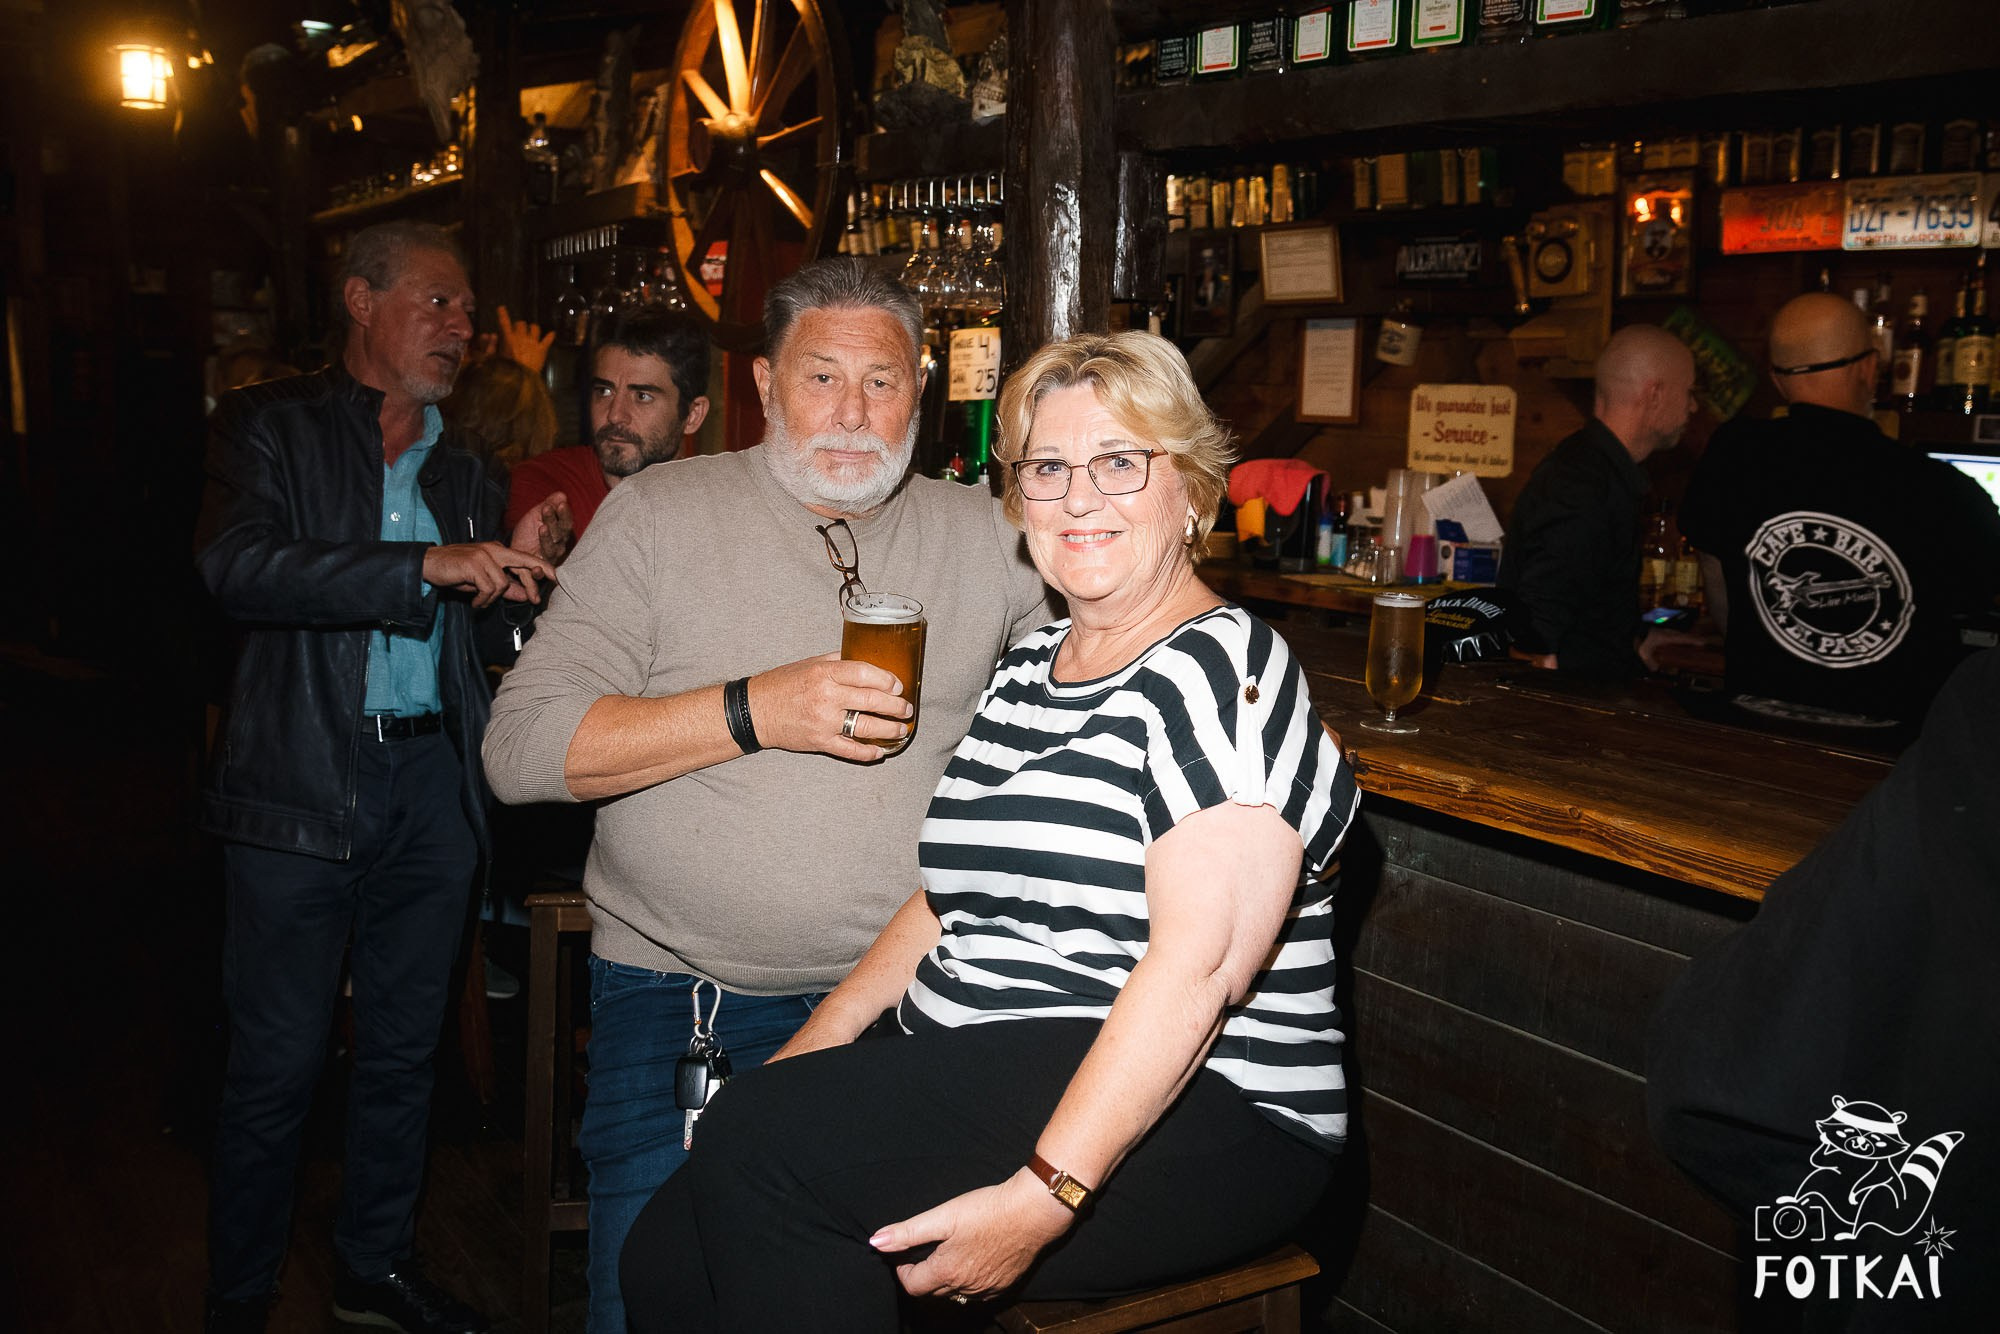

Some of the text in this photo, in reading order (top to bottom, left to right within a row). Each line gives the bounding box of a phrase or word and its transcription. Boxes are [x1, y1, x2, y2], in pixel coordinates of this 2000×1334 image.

[1854, 232, 1966, 243] NORTH CAROLINA
[1436, 398, 1486, 416] guarantee
[1755, 522, 1883, 572] CAFE BAR
[1428, 599, 1465, 609] JACK
[1785, 626, 1883, 654] EL PASO
